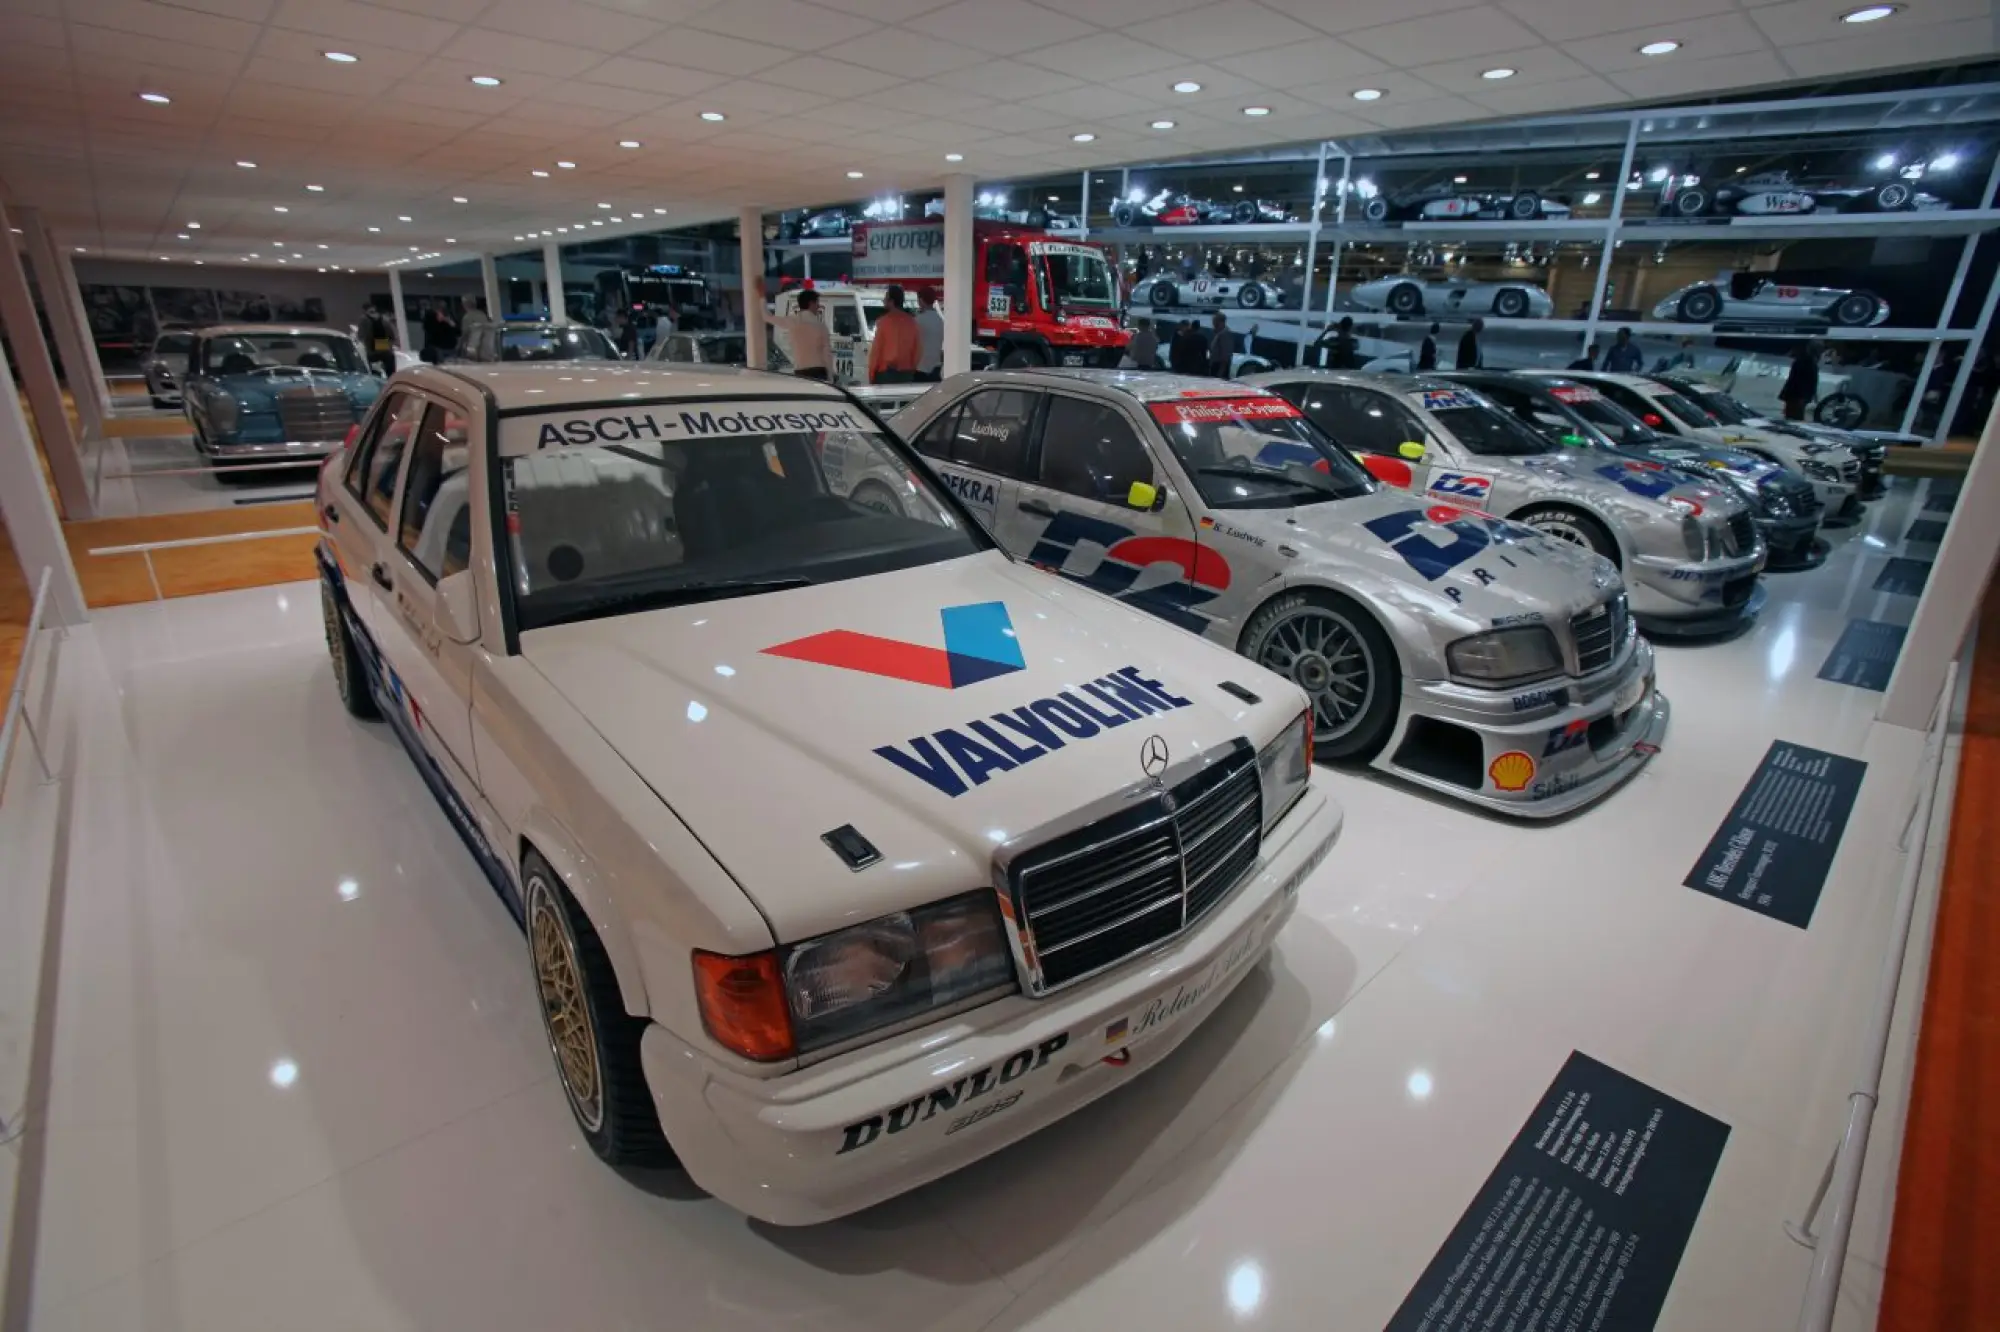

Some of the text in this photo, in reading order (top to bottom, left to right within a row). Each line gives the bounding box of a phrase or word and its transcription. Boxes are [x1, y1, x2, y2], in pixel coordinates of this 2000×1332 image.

[869, 228, 944, 257] eurorep
[537, 409, 861, 450] ASCH-Motorsport
[971, 419, 1009, 442] Ludwig
[1226, 527, 1266, 548] Ludwig
[872, 666, 1194, 798] VALVOLINE
[835, 1031, 1069, 1154] DUNLOP
